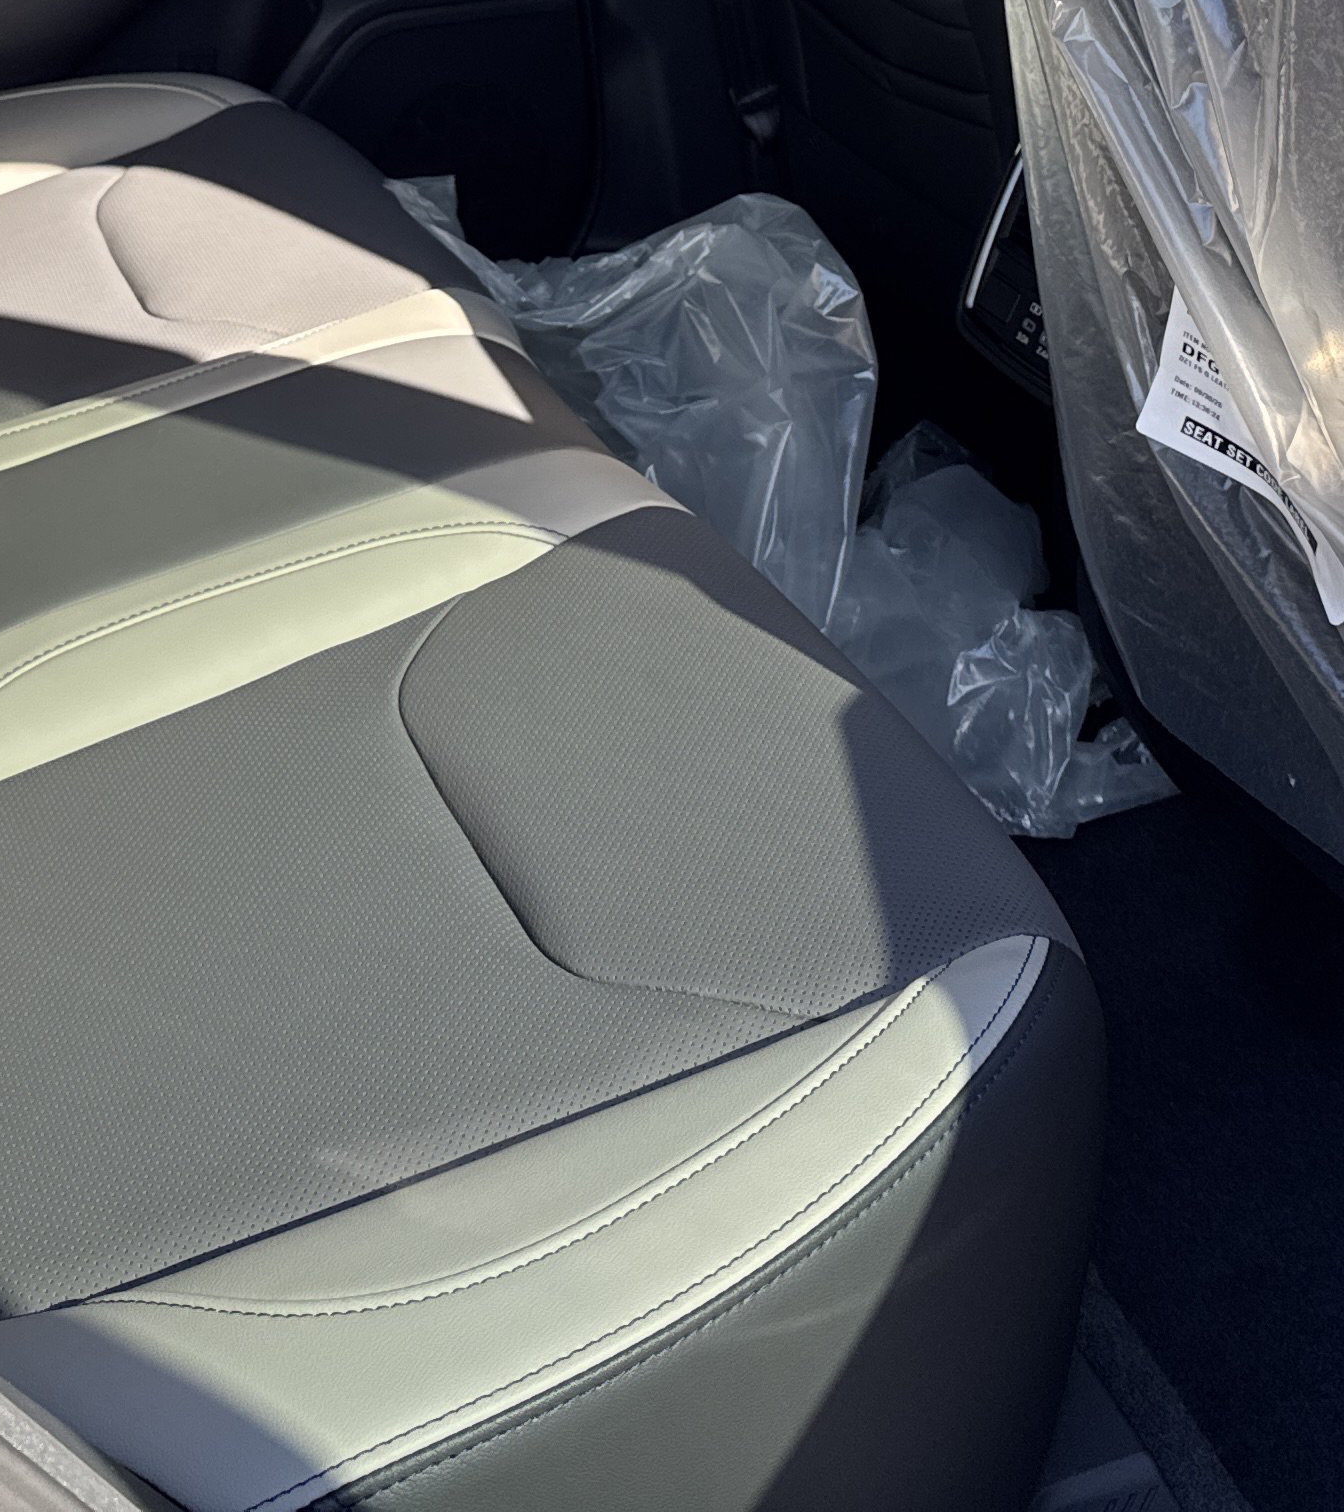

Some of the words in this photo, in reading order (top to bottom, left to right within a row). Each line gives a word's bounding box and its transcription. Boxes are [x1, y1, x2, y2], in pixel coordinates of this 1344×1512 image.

[1174, 375, 1192, 390] Date:
[1171, 388, 1190, 404] TIME:
[1183, 421, 1223, 451] SEAT
[1226, 444, 1254, 468] SET
